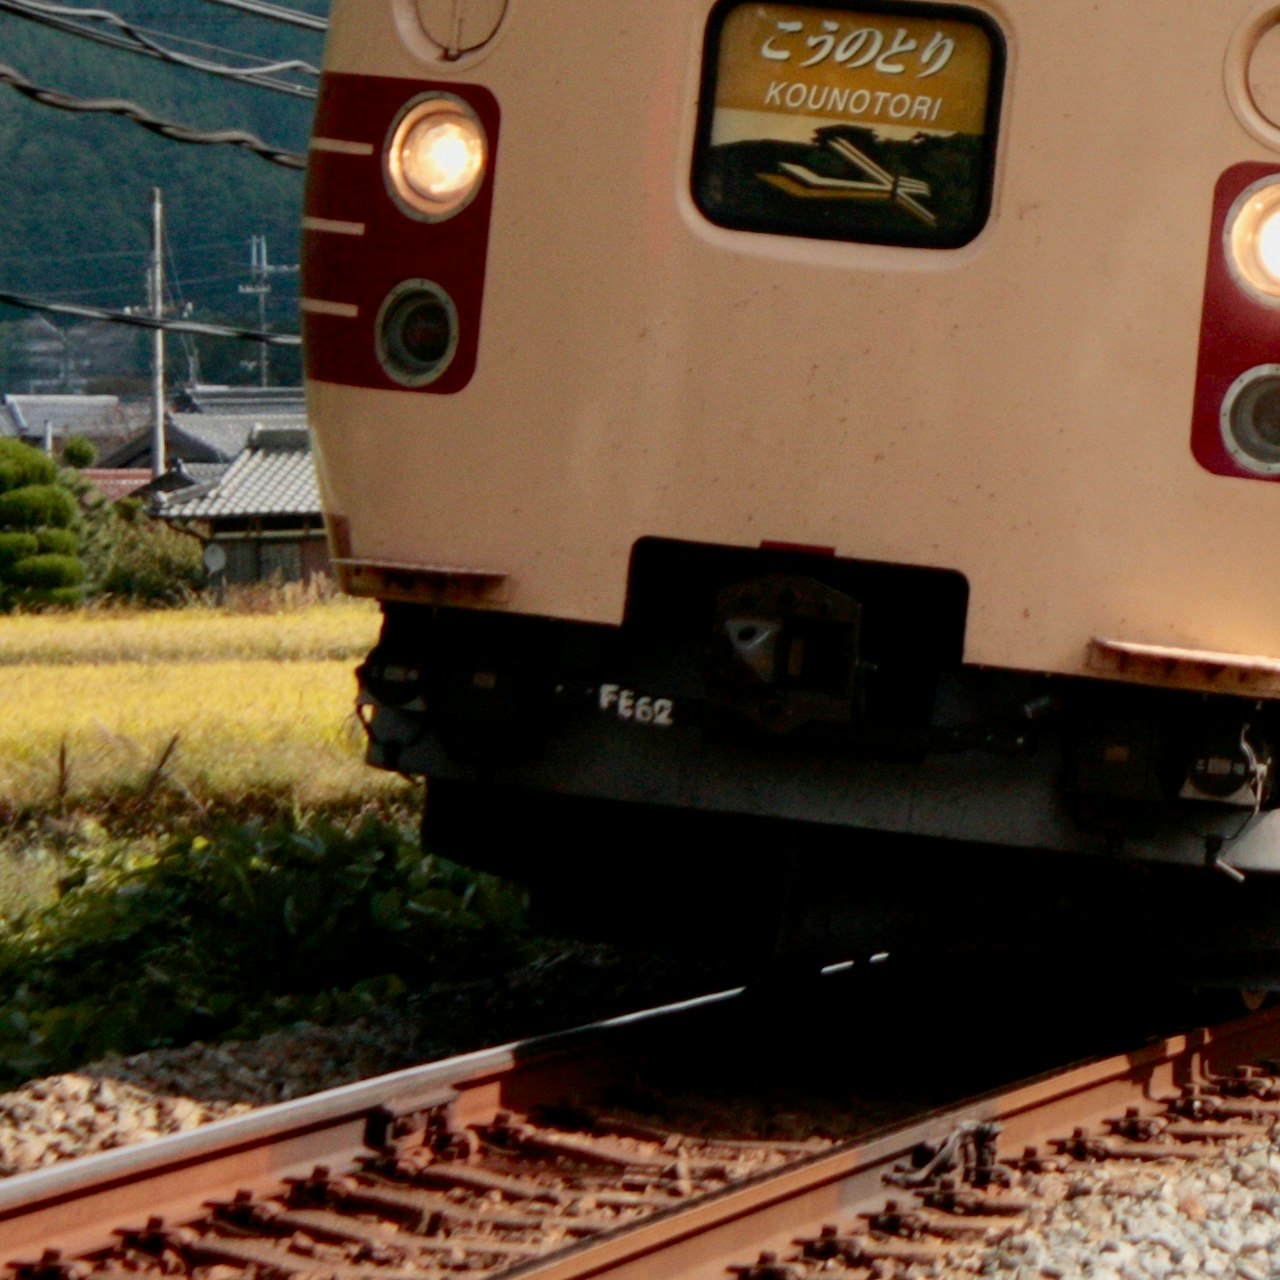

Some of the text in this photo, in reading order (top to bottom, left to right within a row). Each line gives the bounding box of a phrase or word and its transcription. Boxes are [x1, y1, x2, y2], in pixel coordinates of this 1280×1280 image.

[760, 19, 956, 79] こうのとり
[763, 80, 943, 122] KOUNOTORI
[598, 683, 674, 726] FE62
